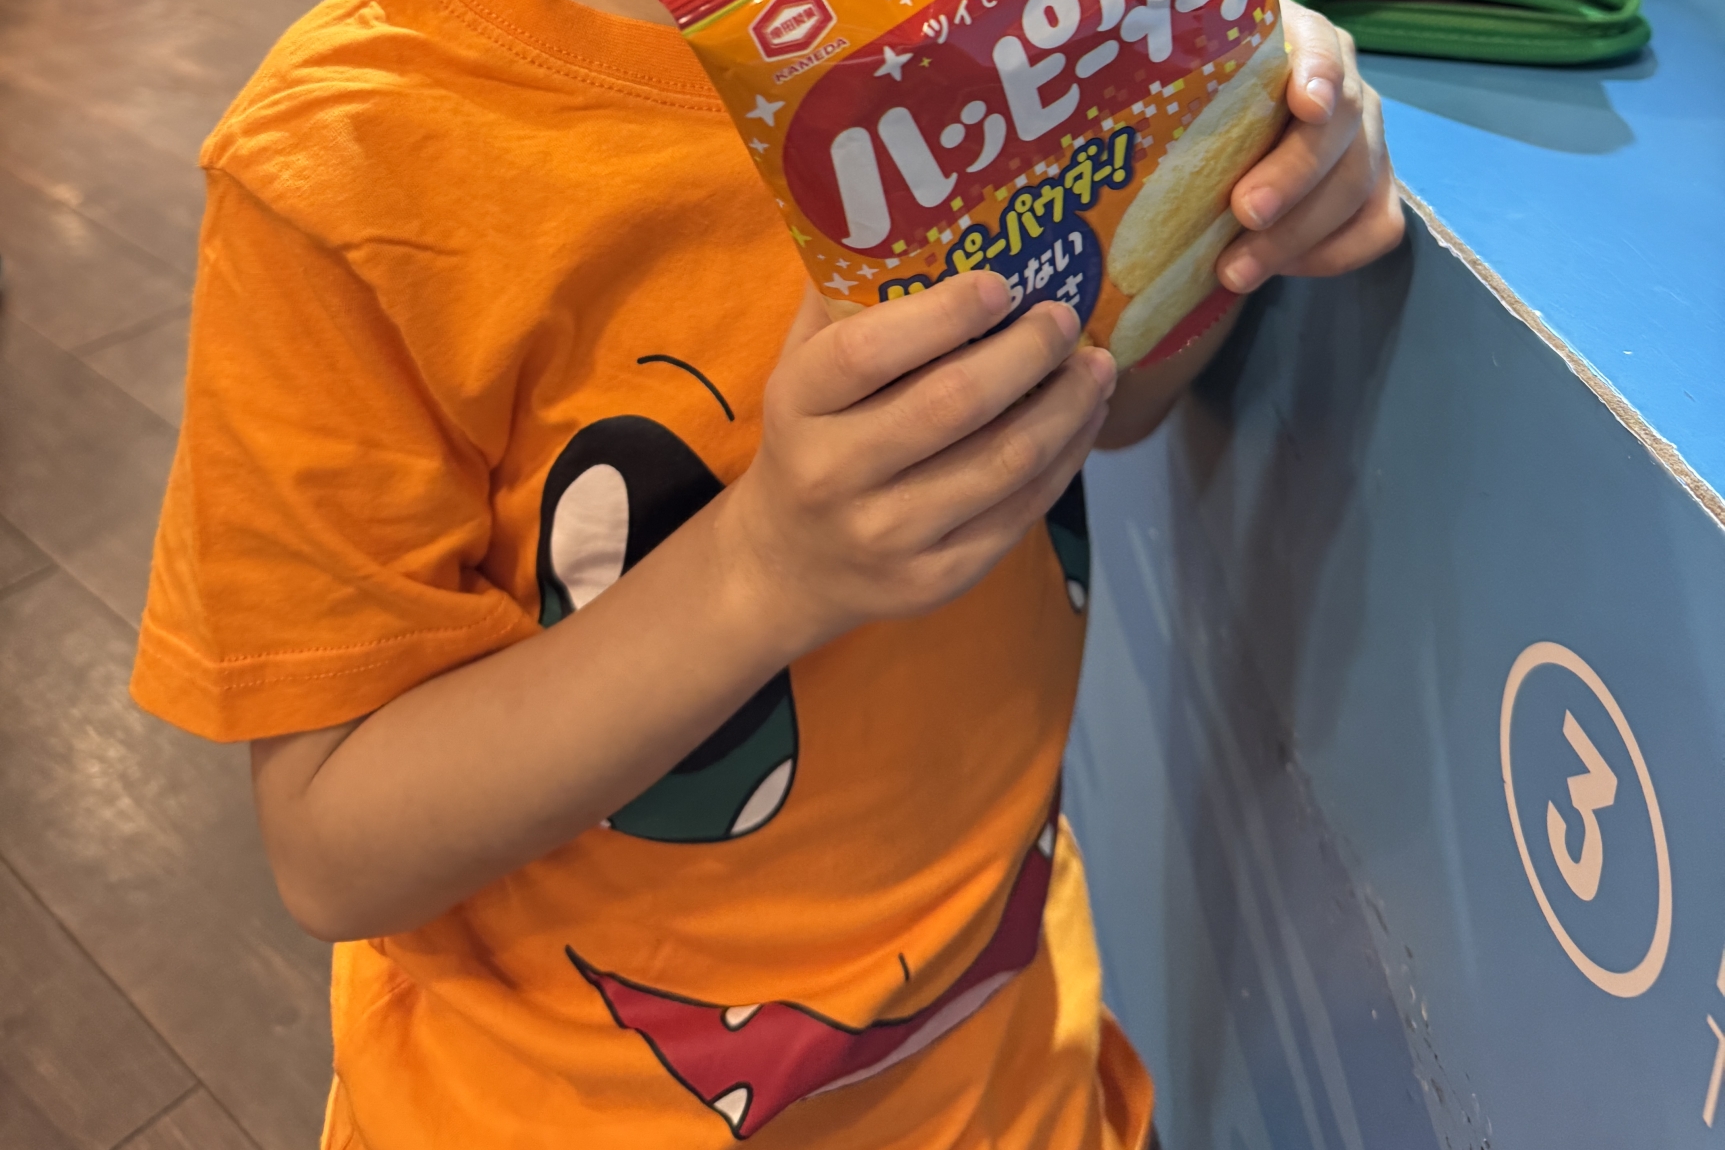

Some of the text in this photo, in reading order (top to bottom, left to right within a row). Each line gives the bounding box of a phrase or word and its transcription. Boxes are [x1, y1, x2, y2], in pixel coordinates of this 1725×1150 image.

[774, 37, 849, 83] KAMEDA
[887, 133, 1128, 301] ピーパウダー!
[1546, 708, 1618, 902] 3
